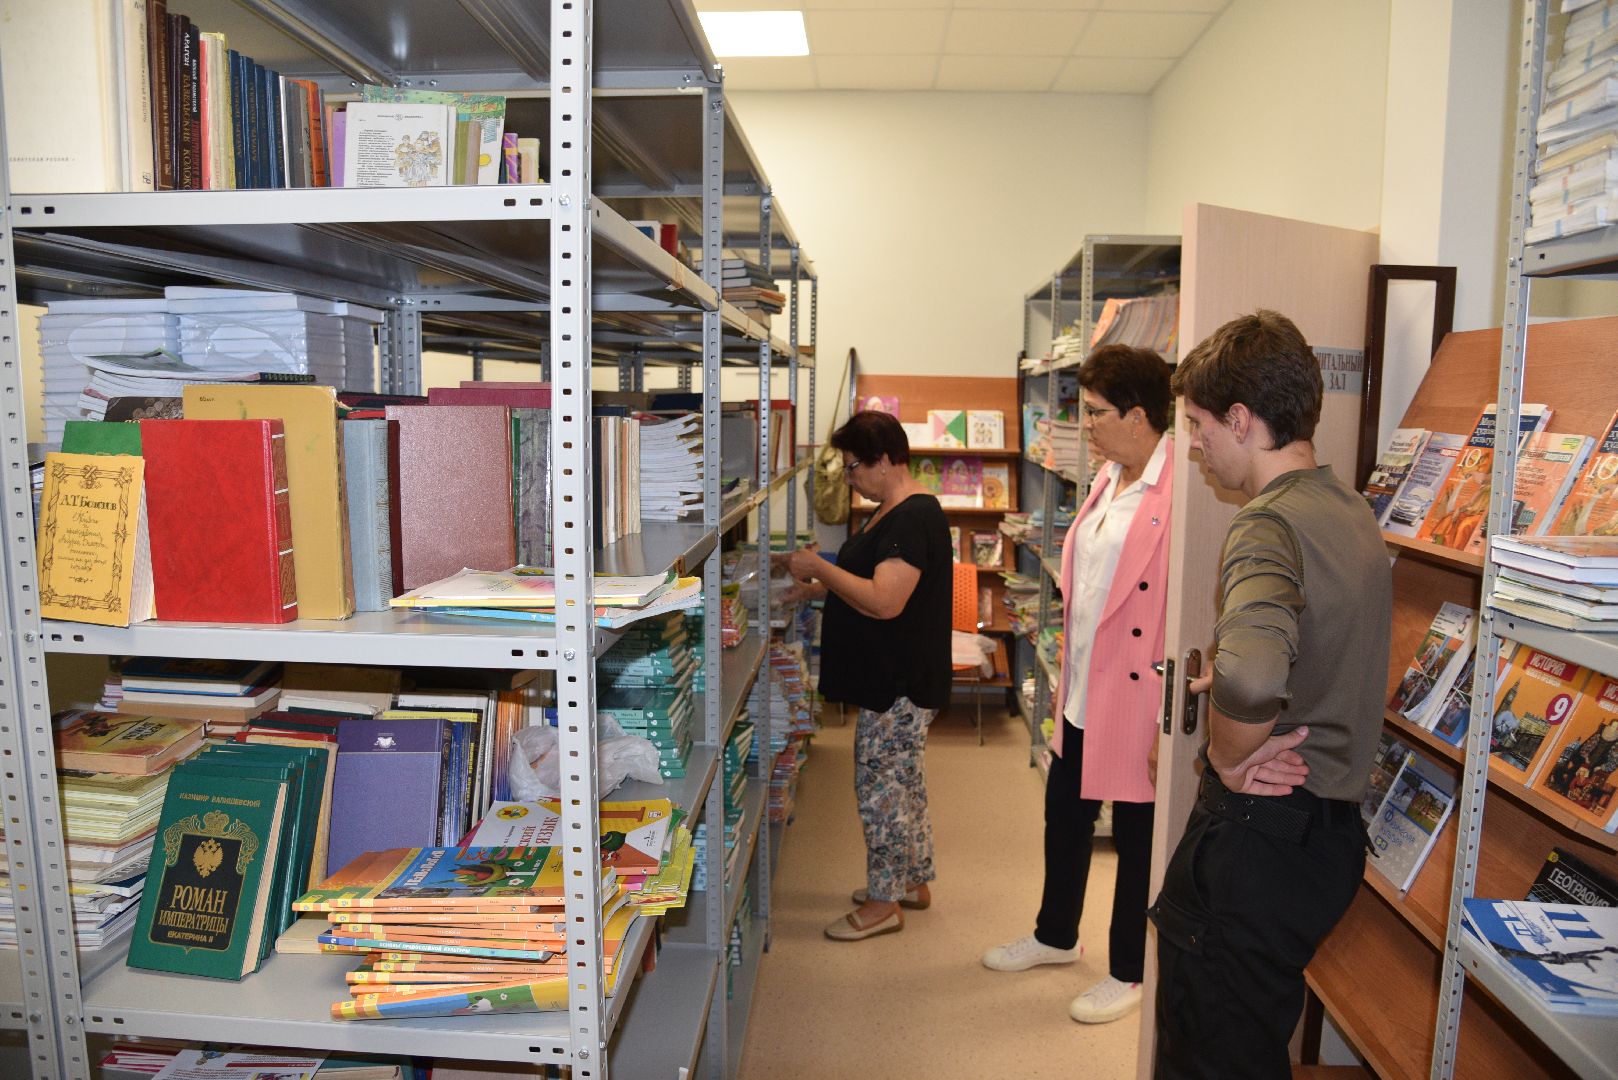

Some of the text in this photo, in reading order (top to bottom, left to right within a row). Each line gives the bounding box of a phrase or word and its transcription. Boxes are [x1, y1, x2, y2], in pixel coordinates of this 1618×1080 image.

[183, 32, 191, 66] АРАГОН
[1328, 372, 1347, 390] ЗАЛ
[1457, 448, 1482, 467] 10
[1585, 456, 1618, 480] 10
[1529, 652, 1567, 677] ИСТОРИЯ
[1548, 697, 1569, 721] 9
[535, 816, 560, 845] ЯЗЫК
[169, 884, 228, 915] РОМАН
[1549, 867, 1610, 908] ГЕОГРАФИЯ
[158, 909, 230, 937] ИМПЕРАТРИЦЫ
[167, 930, 207, 943] ЕКАТЕРИНА
